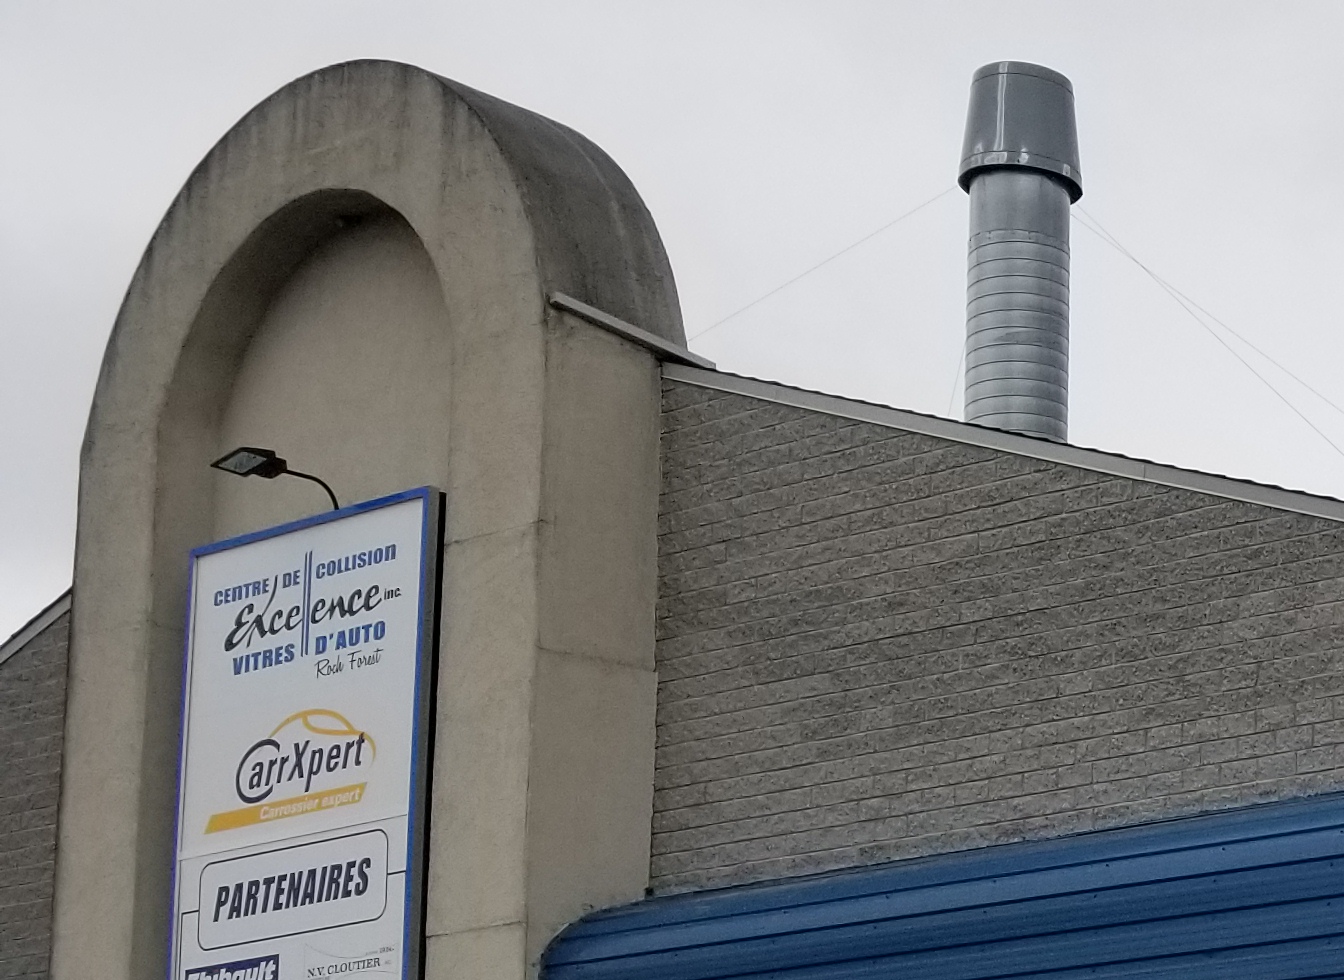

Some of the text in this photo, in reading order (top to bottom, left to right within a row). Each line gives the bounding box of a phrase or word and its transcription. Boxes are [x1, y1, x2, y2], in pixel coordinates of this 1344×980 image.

[213, 543, 397, 607] CENTRE DE COLLISION
[233, 620, 387, 676] VITRES D'AUTO
[347, 648, 384, 669] Forest
[235, 732, 366, 804] CarrXpert
[213, 857, 372, 923] PARTENAIRES
[327, 957, 381, 976] CLOUTIER
